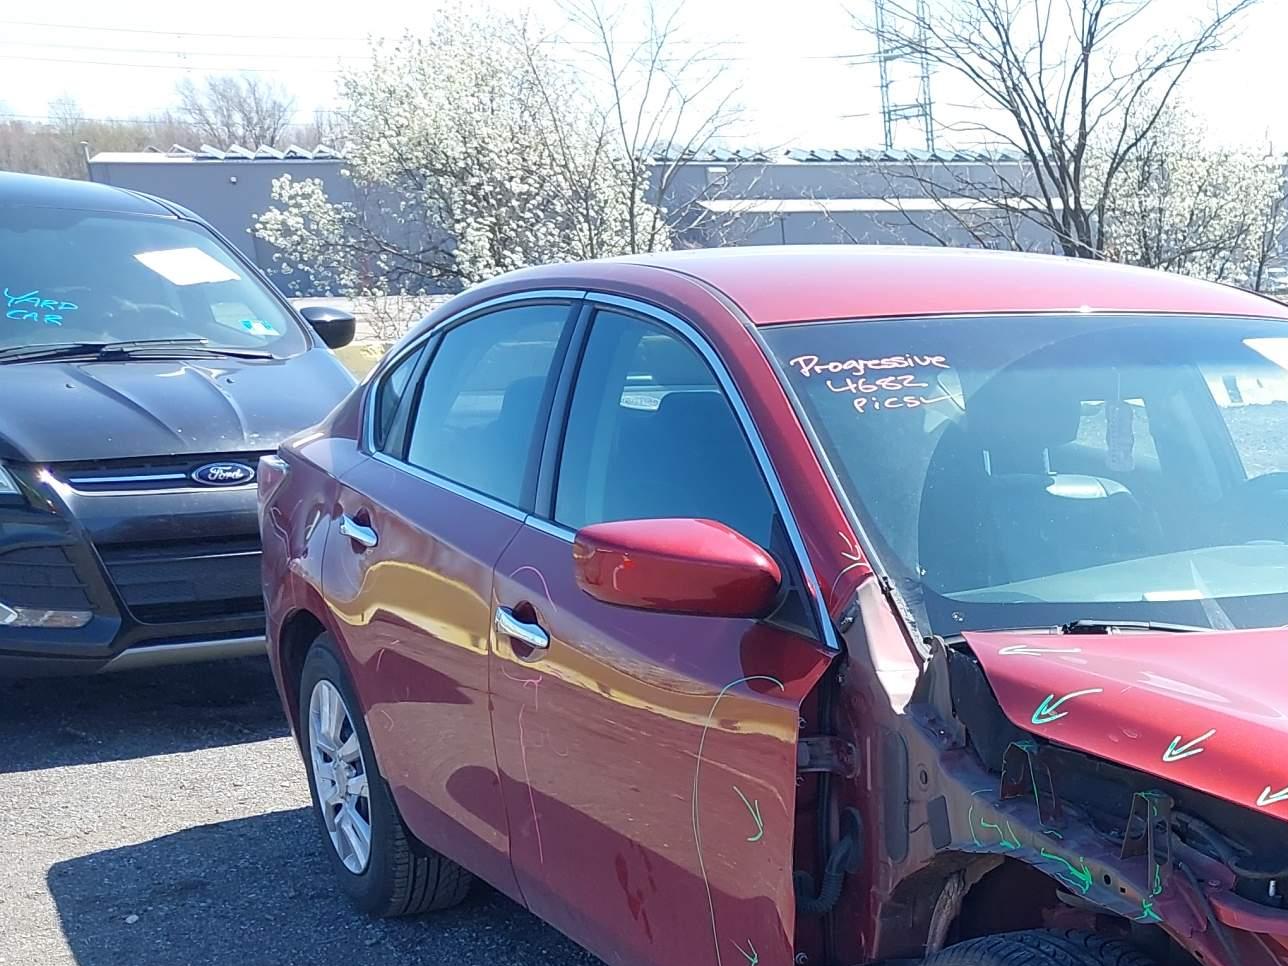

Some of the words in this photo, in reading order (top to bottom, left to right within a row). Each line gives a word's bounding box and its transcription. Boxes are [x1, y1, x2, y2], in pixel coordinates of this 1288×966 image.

[3, 287, 79, 310] YARD
[6, 309, 64, 327] CAR
[789, 354, 951, 377] Progressive
[826, 374, 929, 394] 4682
[208, 466, 244, 480] Ford
